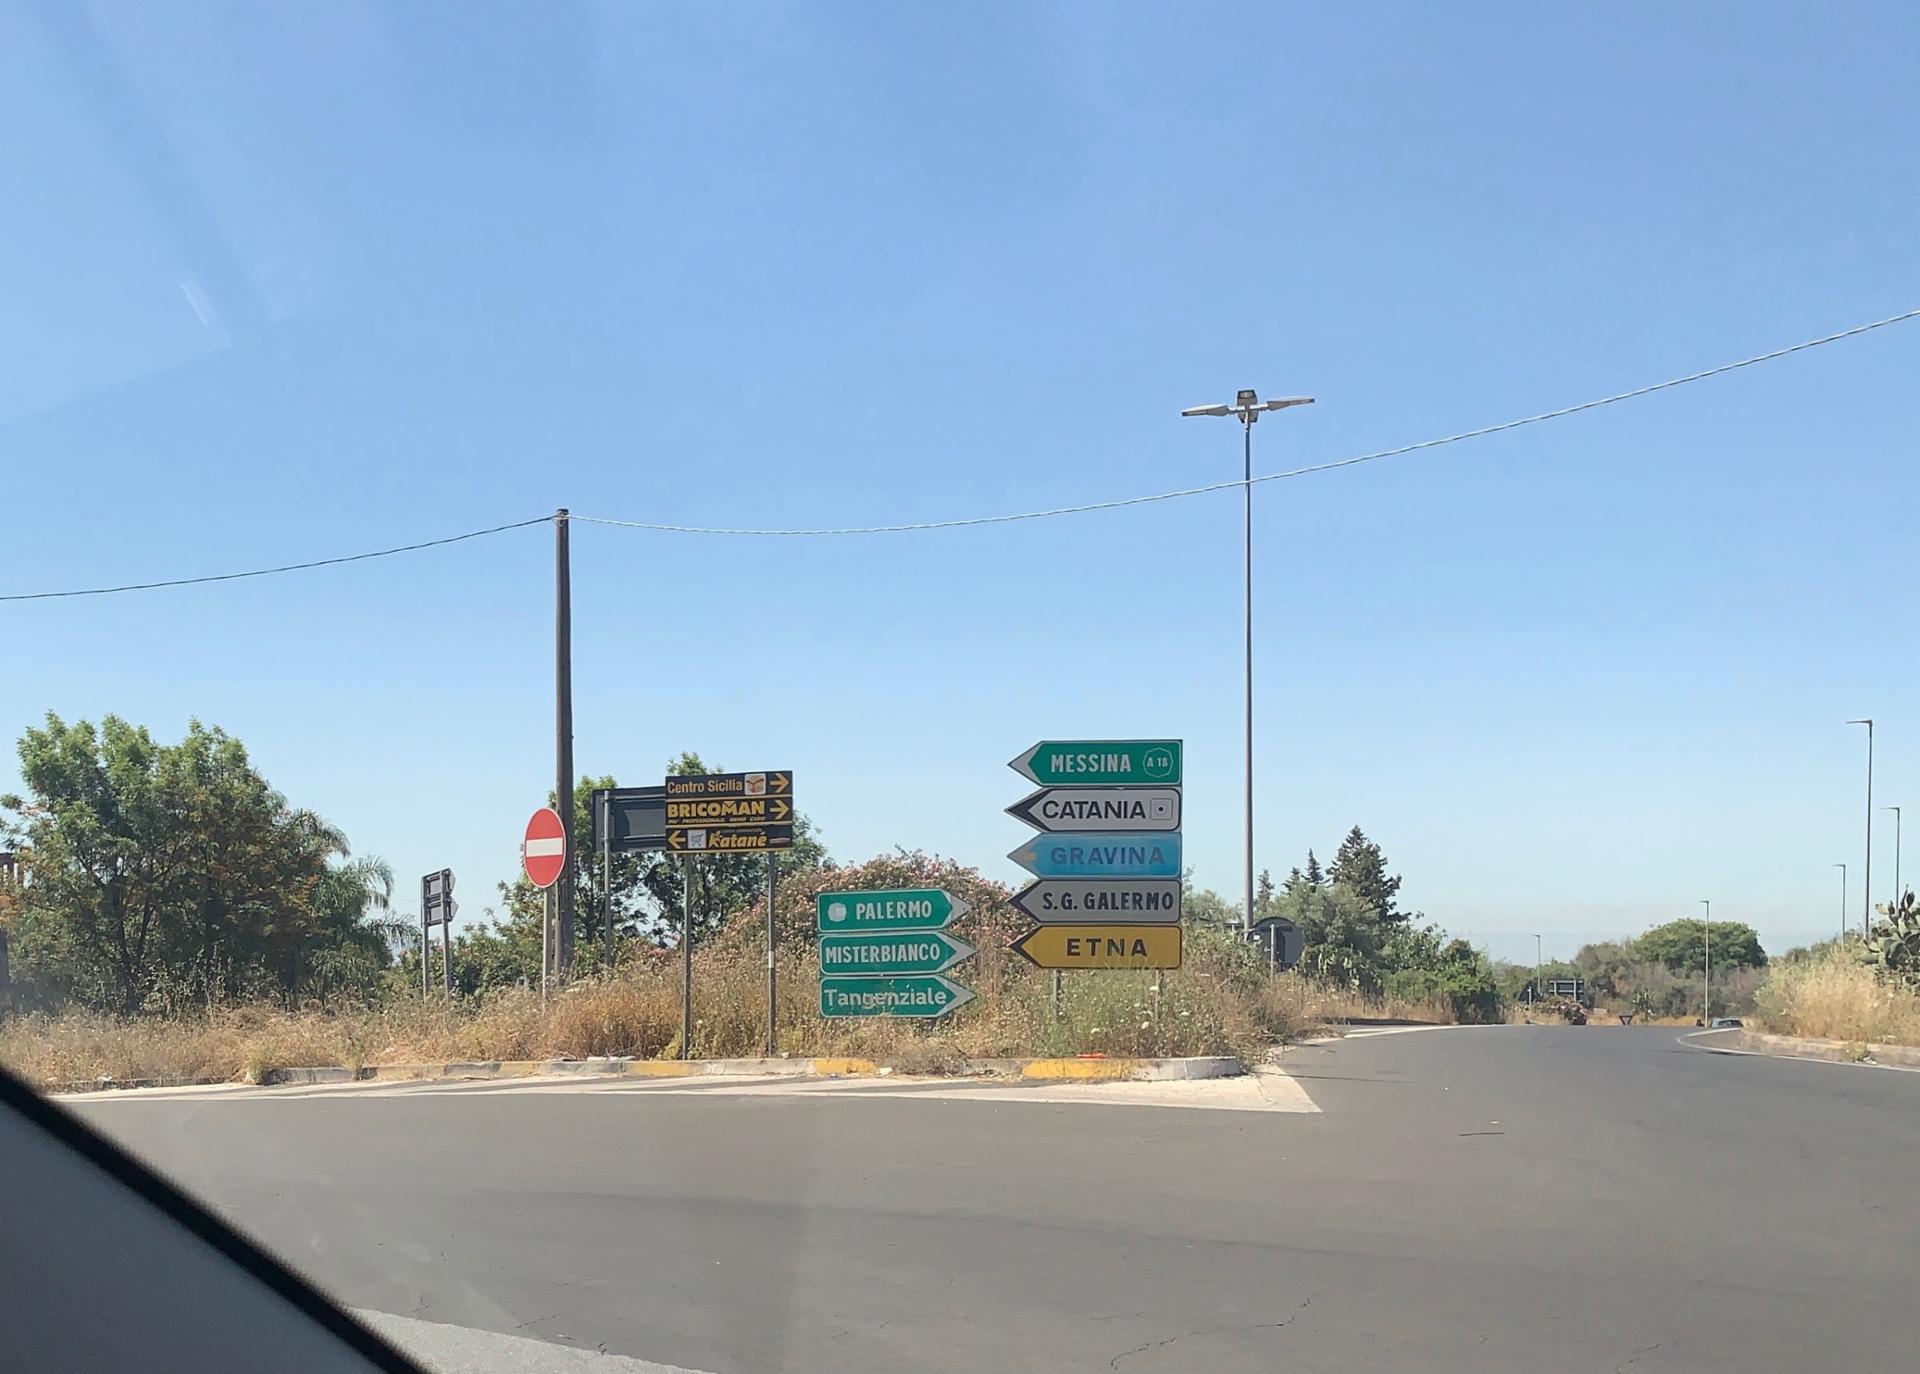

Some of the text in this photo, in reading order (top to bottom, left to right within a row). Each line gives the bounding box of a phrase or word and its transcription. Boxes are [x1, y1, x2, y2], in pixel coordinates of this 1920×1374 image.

[1051, 754, 1131, 773] MESSINA
[1147, 757, 1168, 767] A 18
[667, 779, 743, 794] Centro Sicilia
[667, 801, 765, 818] BRICOMAN
[1042, 800, 1146, 819] CATANIA
[709, 830, 767, 848] Katané
[1051, 847, 1164, 865] GRAVINA
[856, 900, 932, 920] PALERMO
[1042, 892, 1174, 911] S.G. GALERMO
[825, 943, 940, 964] MISTERBIANCO
[1067, 938, 1148, 957] ETNA
[823, 987, 947, 1010] Tangenziale
